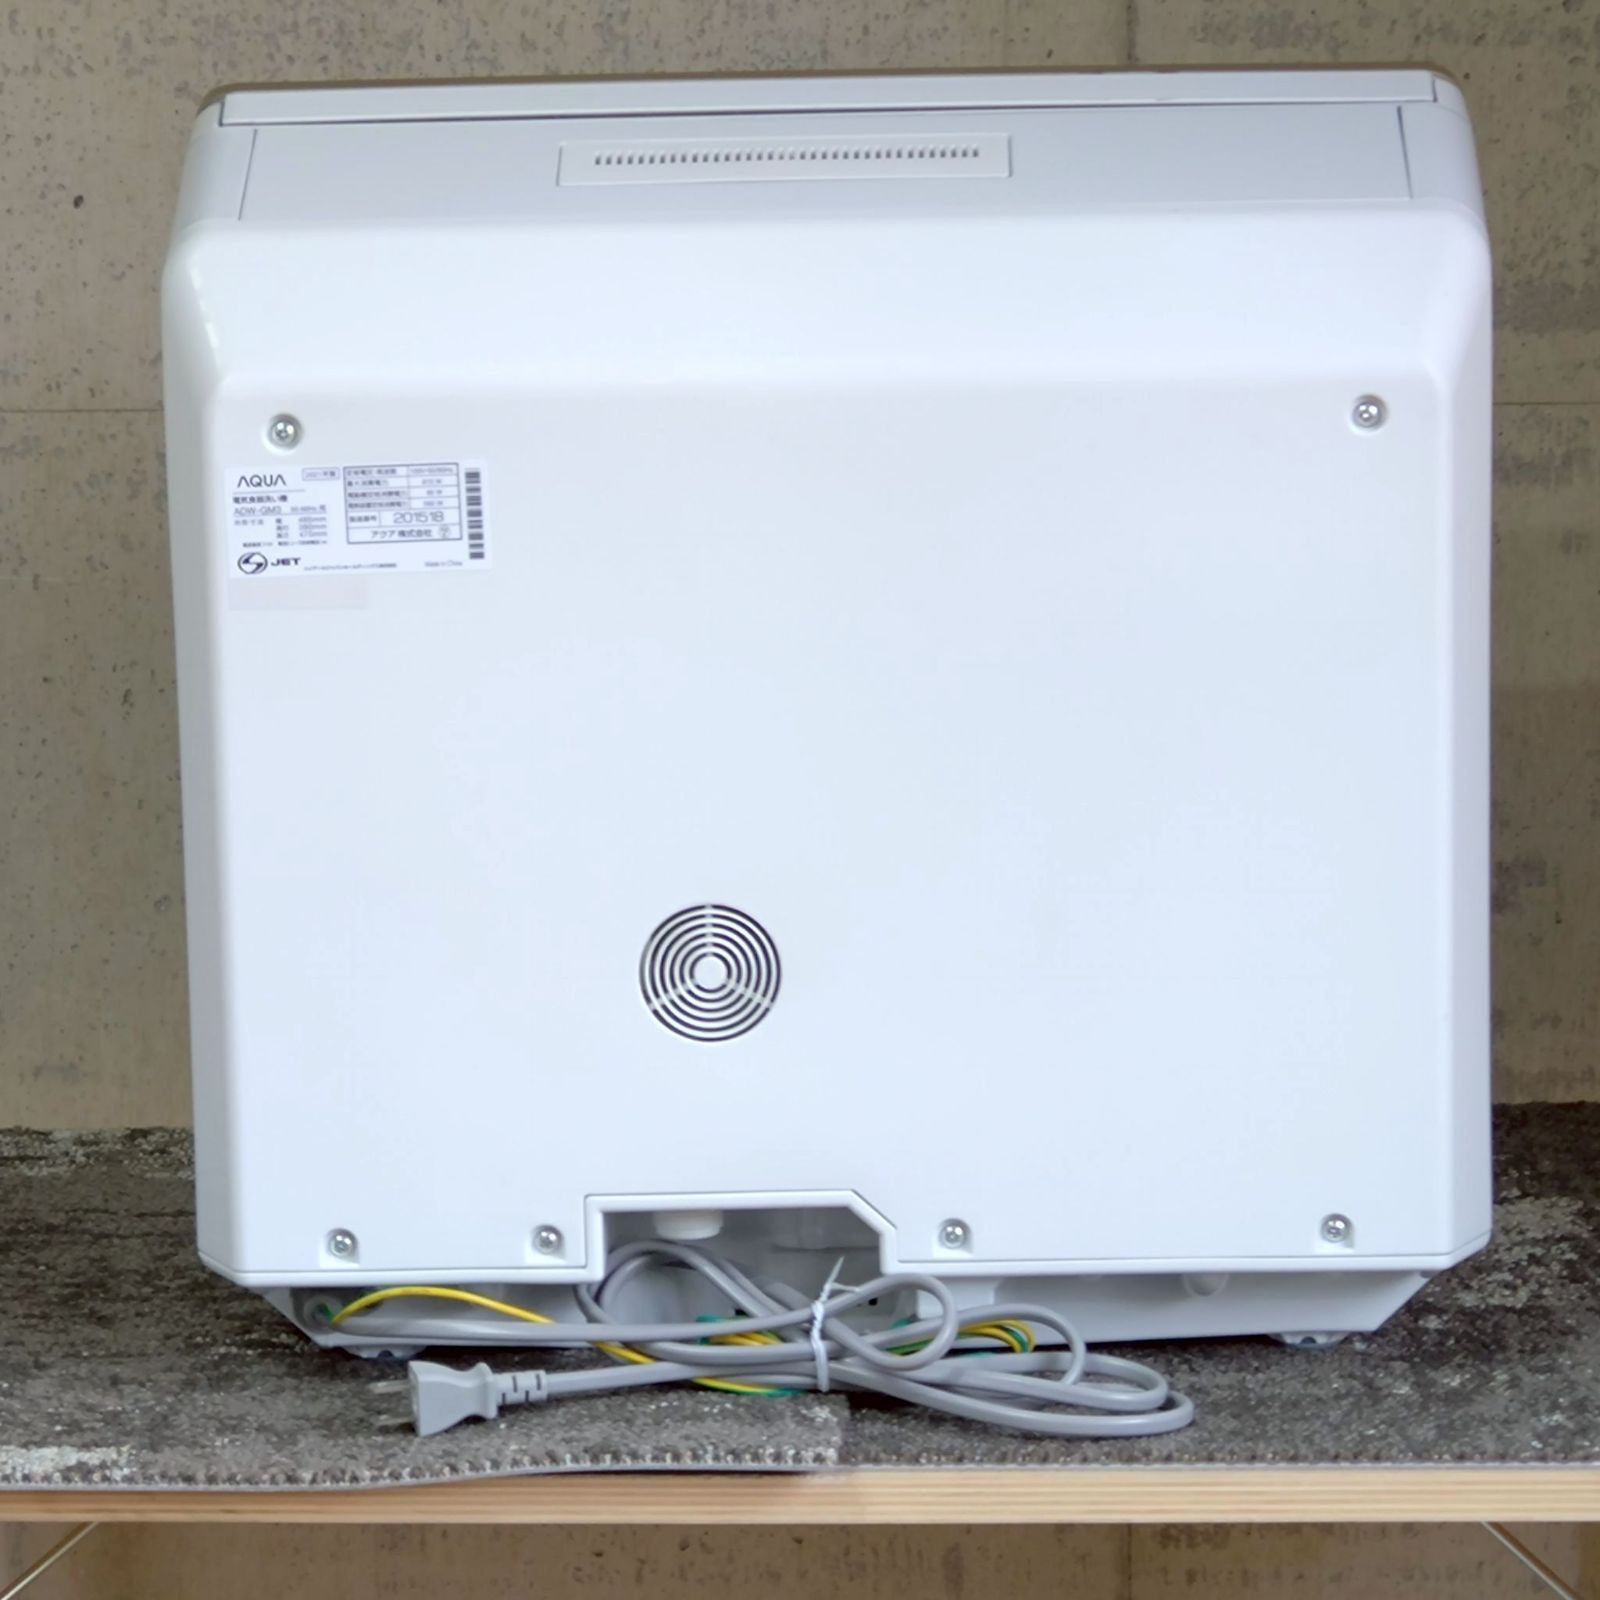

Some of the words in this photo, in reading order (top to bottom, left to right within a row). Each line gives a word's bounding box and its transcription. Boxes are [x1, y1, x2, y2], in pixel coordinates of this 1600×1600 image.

[237, 474, 287, 488] AQUA
[393, 511, 445, 524] 201518
[271, 557, 301, 566] JET
